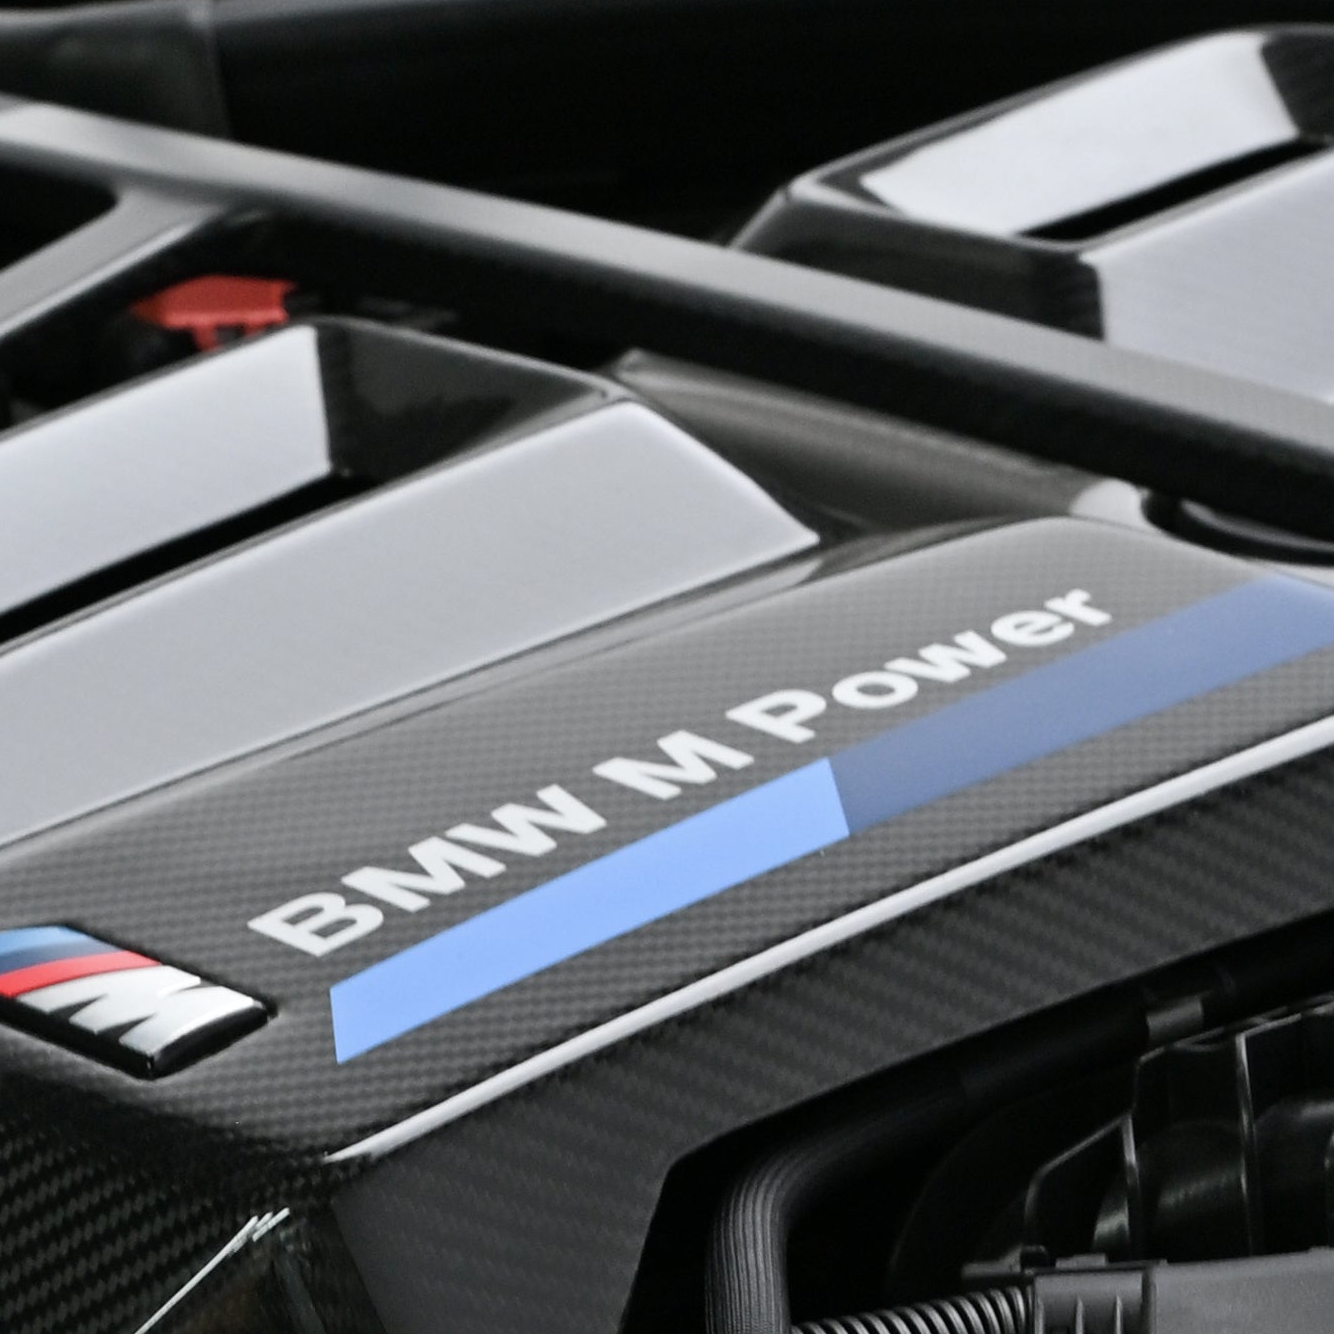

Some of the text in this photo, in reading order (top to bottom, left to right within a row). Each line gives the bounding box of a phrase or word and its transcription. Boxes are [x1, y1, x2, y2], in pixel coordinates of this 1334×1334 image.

[247, 586, 1114, 958] BMW M Power
